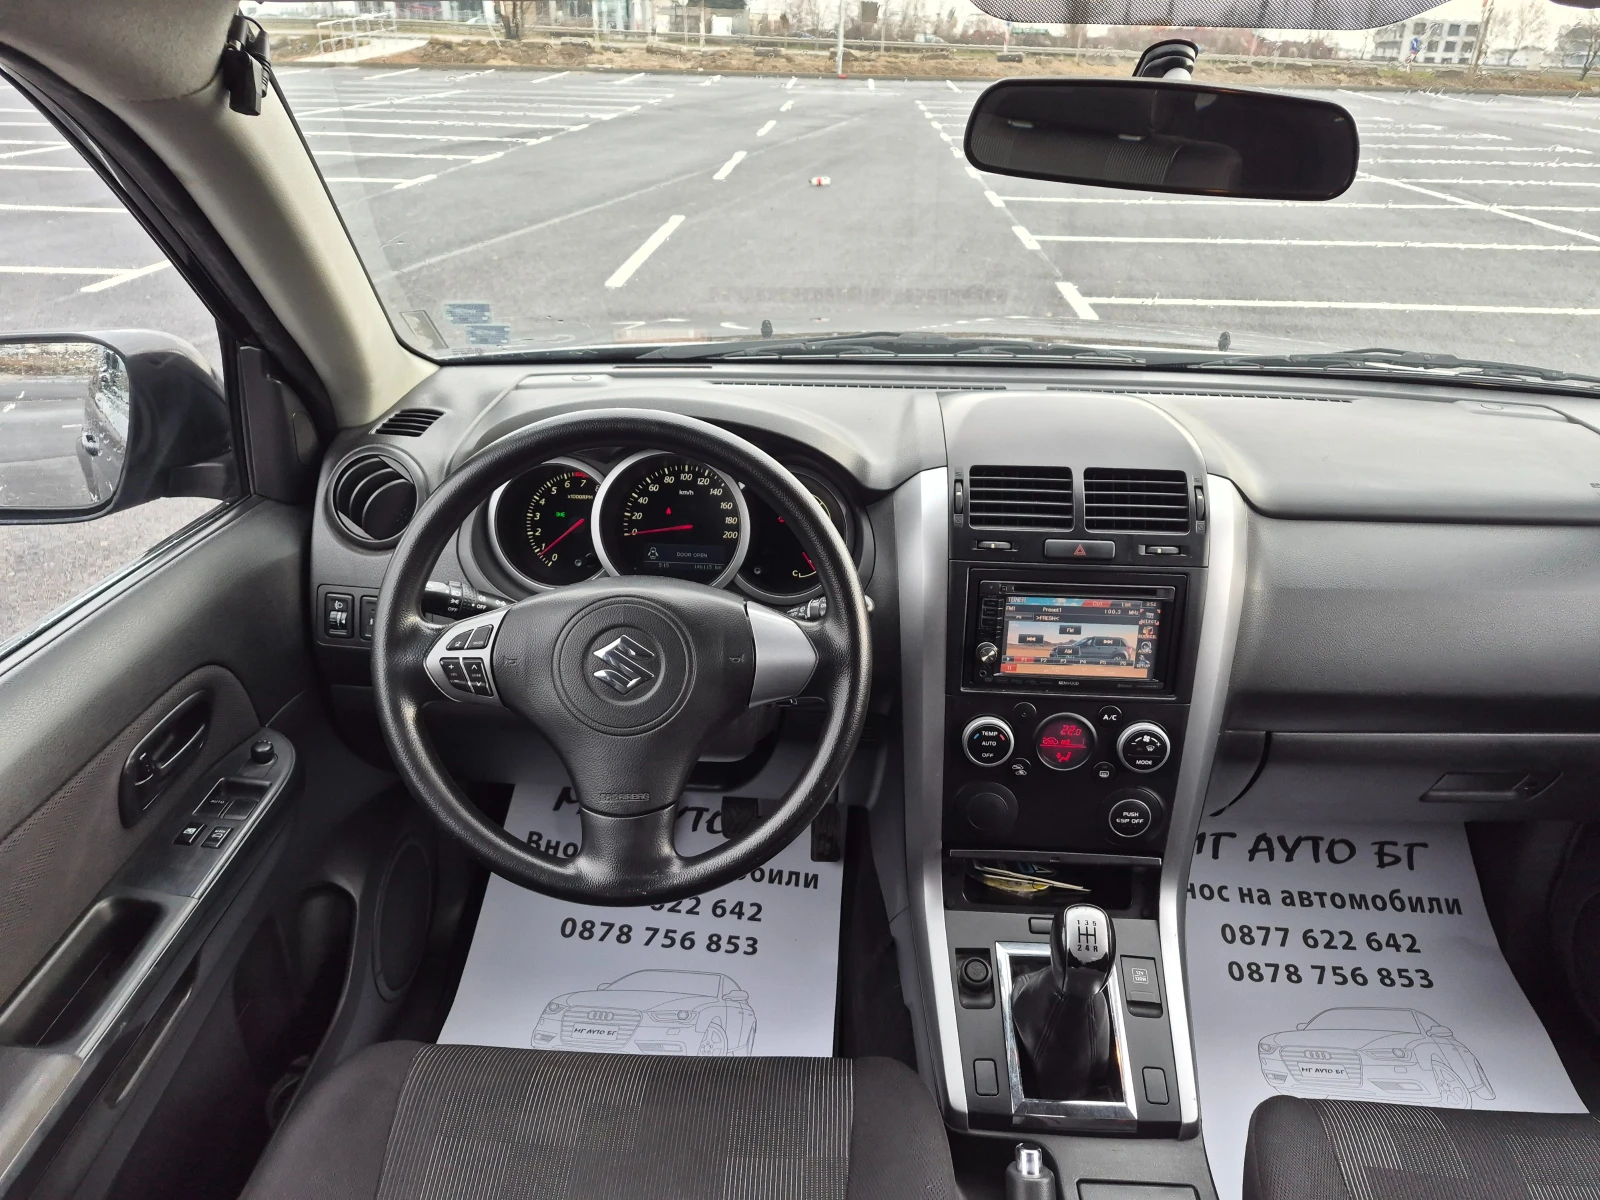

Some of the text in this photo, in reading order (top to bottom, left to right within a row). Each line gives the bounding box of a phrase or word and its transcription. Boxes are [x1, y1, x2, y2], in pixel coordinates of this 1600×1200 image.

[564, 480, 571, 488] 6
[697, 477, 710, 485] 120
[551, 486, 557, 495] 5
[709, 488, 723, 496] 140
[534, 512, 540, 520] 3
[631, 512, 642, 520] 20
[725, 516, 738, 525] 180
[631, 528, 638, 536] 0
[551, 553, 558, 561] 0
[1102, 714, 1118, 722] A/C
[1186, 882, 1463, 916] нос на автомобили
[650, 896, 763, 922] 22 642
[560, 917, 759, 956] 0878 756 853
[1220, 923, 1422, 954] 0877 622 642
[1227, 960, 1434, 989] 0878 756 853
